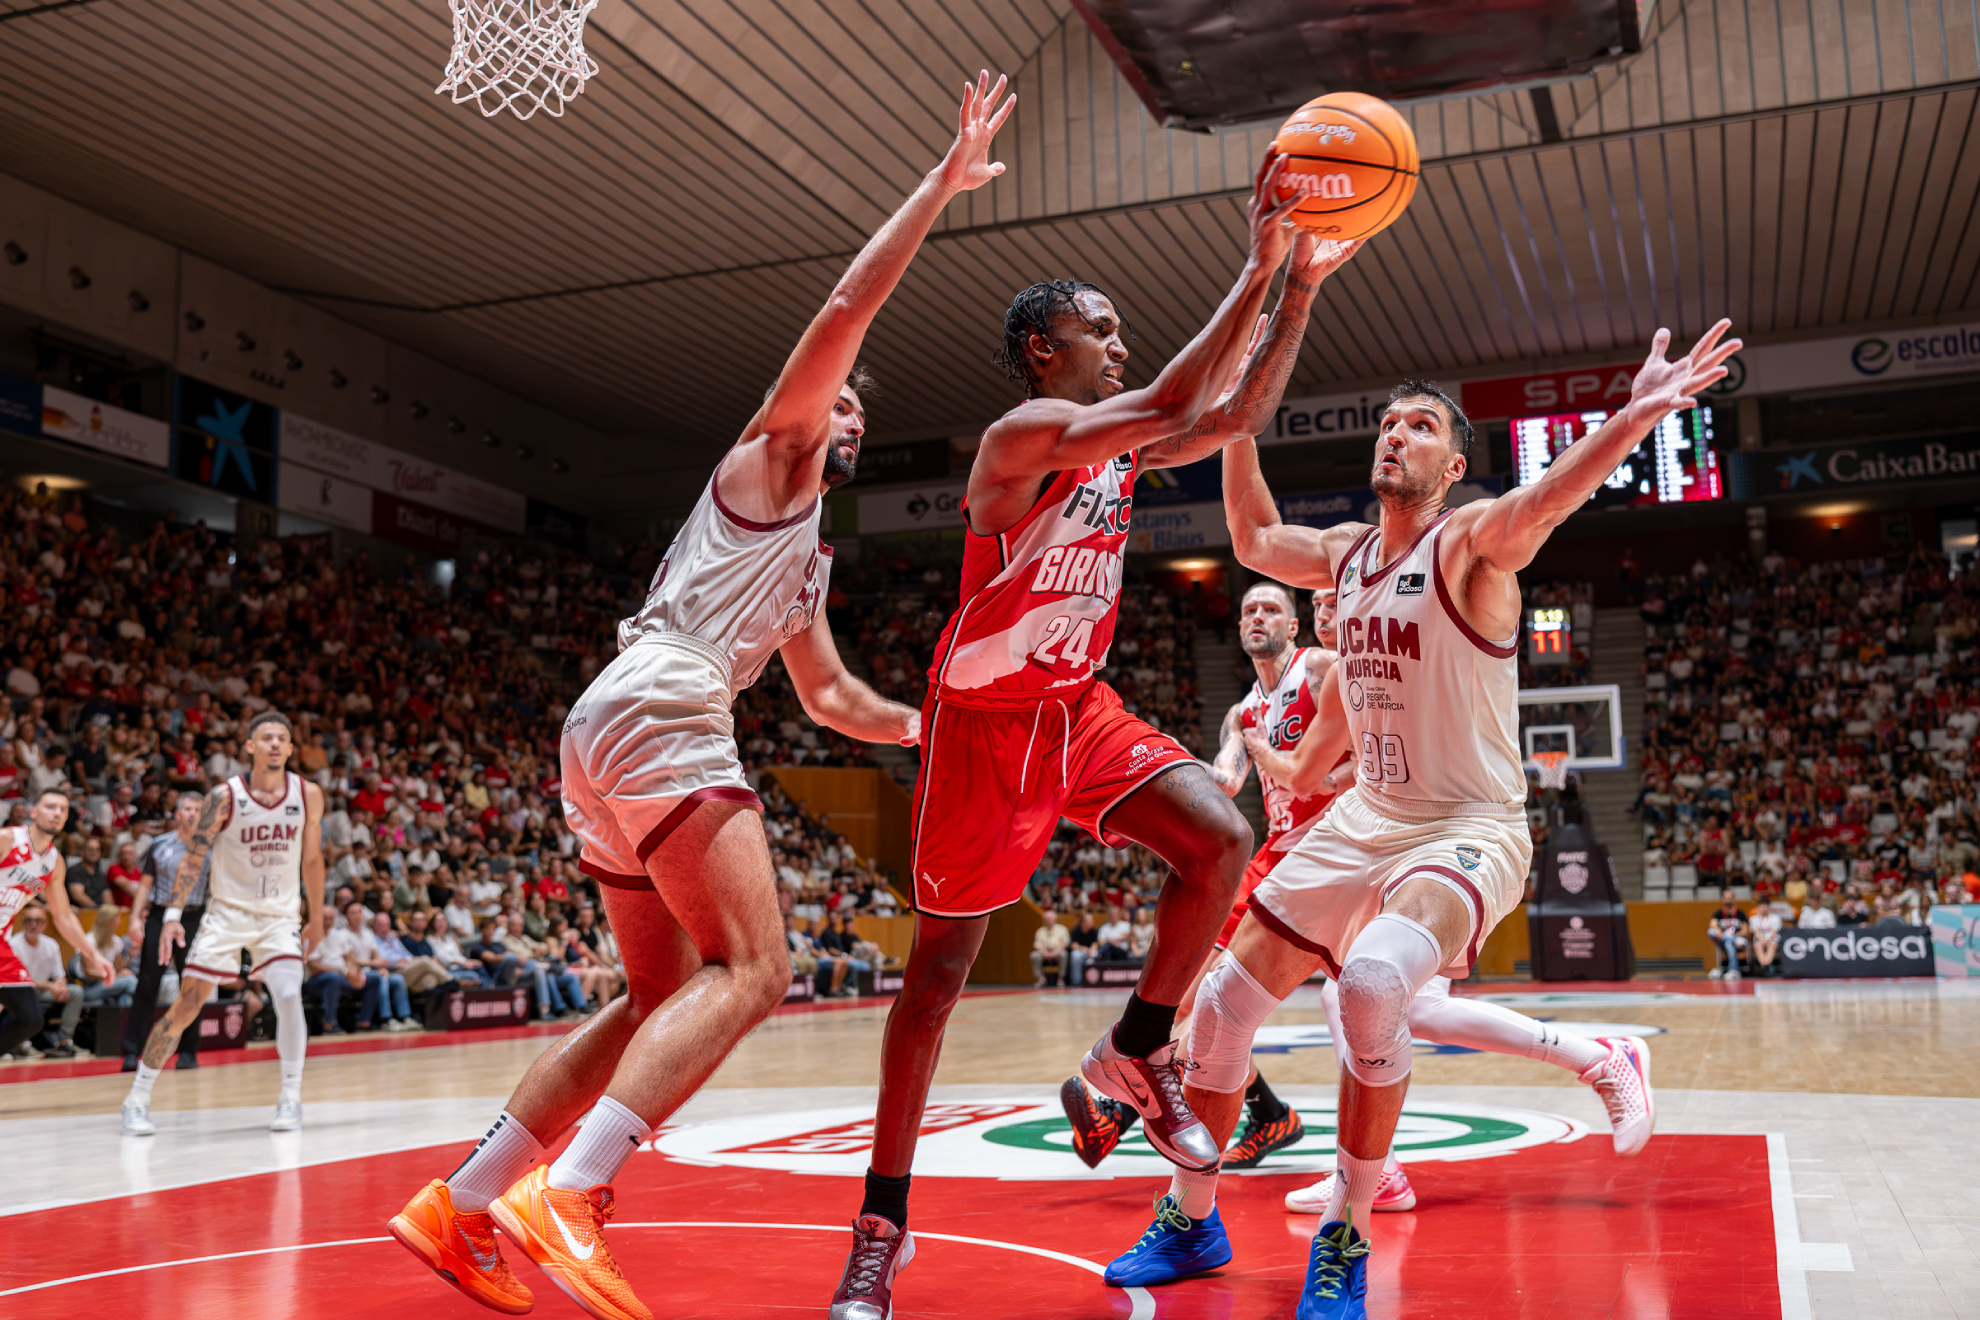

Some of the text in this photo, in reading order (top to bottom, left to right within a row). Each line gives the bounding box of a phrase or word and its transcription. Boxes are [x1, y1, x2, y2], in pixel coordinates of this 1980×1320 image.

[1154, 530, 1205, 550] Blaus
[1032, 614, 1097, 664] 24
[1340, 616, 1422, 661] UCAM
[1531, 630, 1562, 654] 11
[1346, 658, 1403, 683] MURCIA
[1367, 701, 1405, 711] DE MURCIA
[1125, 761, 1146, 777] Pirineu
[1154, 750, 1174, 758] Girona
[1128, 746, 1164, 768] Costa Brava
[1361, 731, 1411, 784] 99
[241, 823, 298, 844] UCAM
[250, 843, 289, 853] MURCIA
[1782, 930, 1928, 961] endesa
